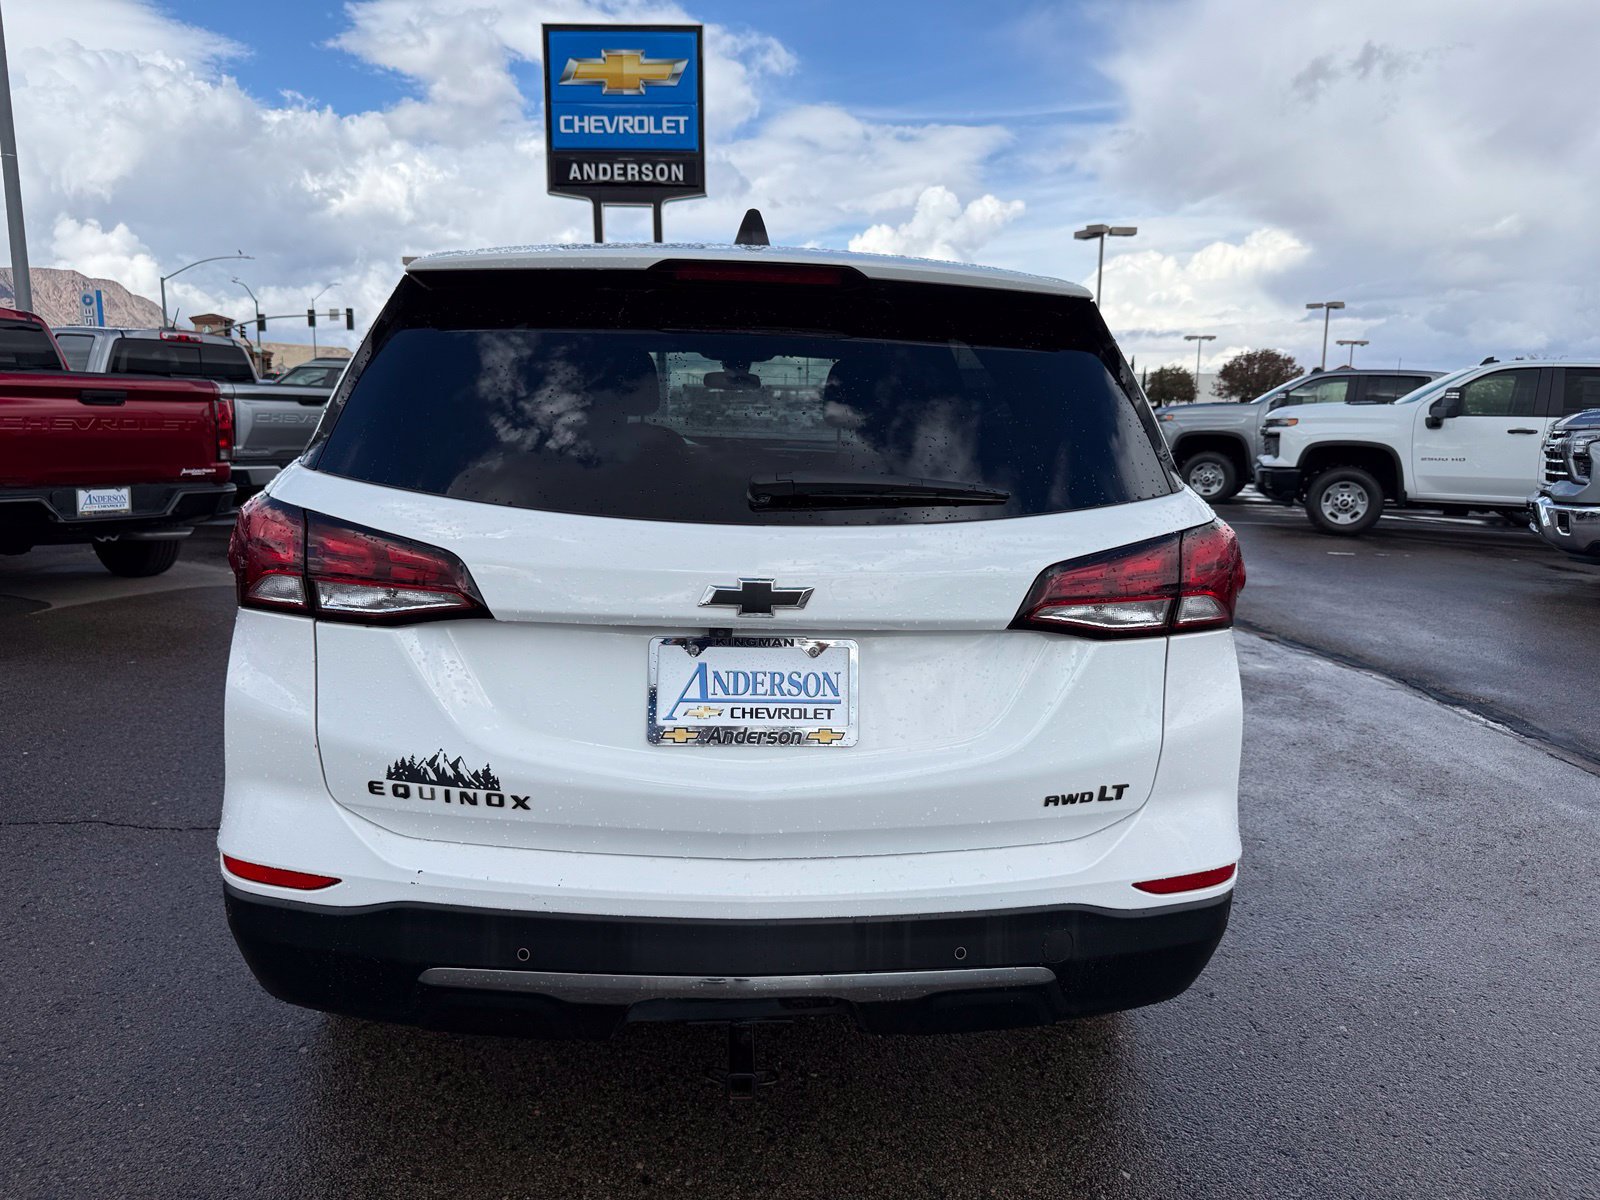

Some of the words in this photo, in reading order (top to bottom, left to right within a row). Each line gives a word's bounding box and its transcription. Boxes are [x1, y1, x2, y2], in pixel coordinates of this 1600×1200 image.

[559, 115, 689, 134] CHEVROLET
[569, 162, 684, 181] ANDERSON
[81, 494, 127, 510] ANDERSON
[714, 637, 795, 648] KINGMAN
[662, 661, 842, 720] ANDERSON
[730, 707, 835, 720] CHEVROLET
[706, 727, 803, 745] Anderson
[367, 780, 532, 810] EQUINOX
[1043, 791, 1094, 807] AWD
[1097, 783, 1130, 802] LT
